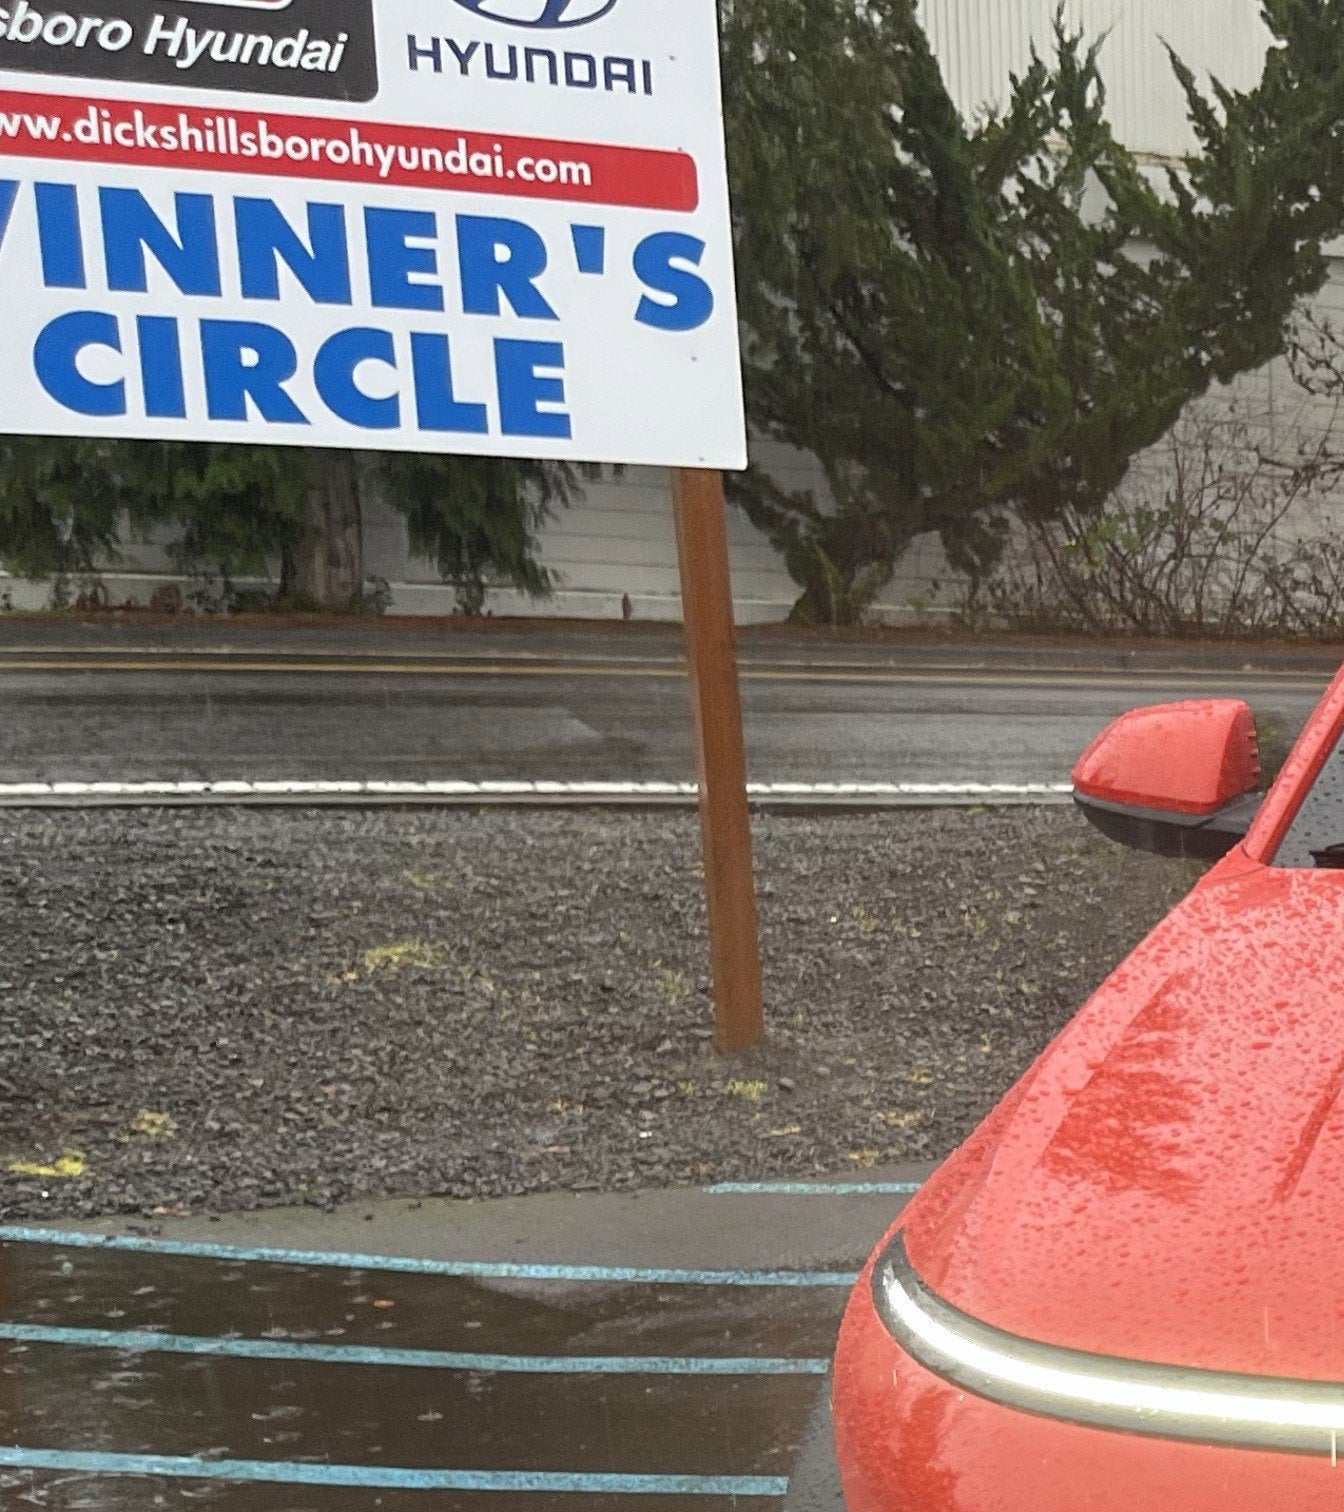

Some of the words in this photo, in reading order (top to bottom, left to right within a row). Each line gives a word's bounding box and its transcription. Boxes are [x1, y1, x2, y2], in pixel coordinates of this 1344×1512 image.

[143, 14, 348, 74] Hyundai
[407, 34, 653, 96] HYUNDAI
[0, 179, 715, 332] INNER'S
[33, 310, 572, 440] CIRCLE
